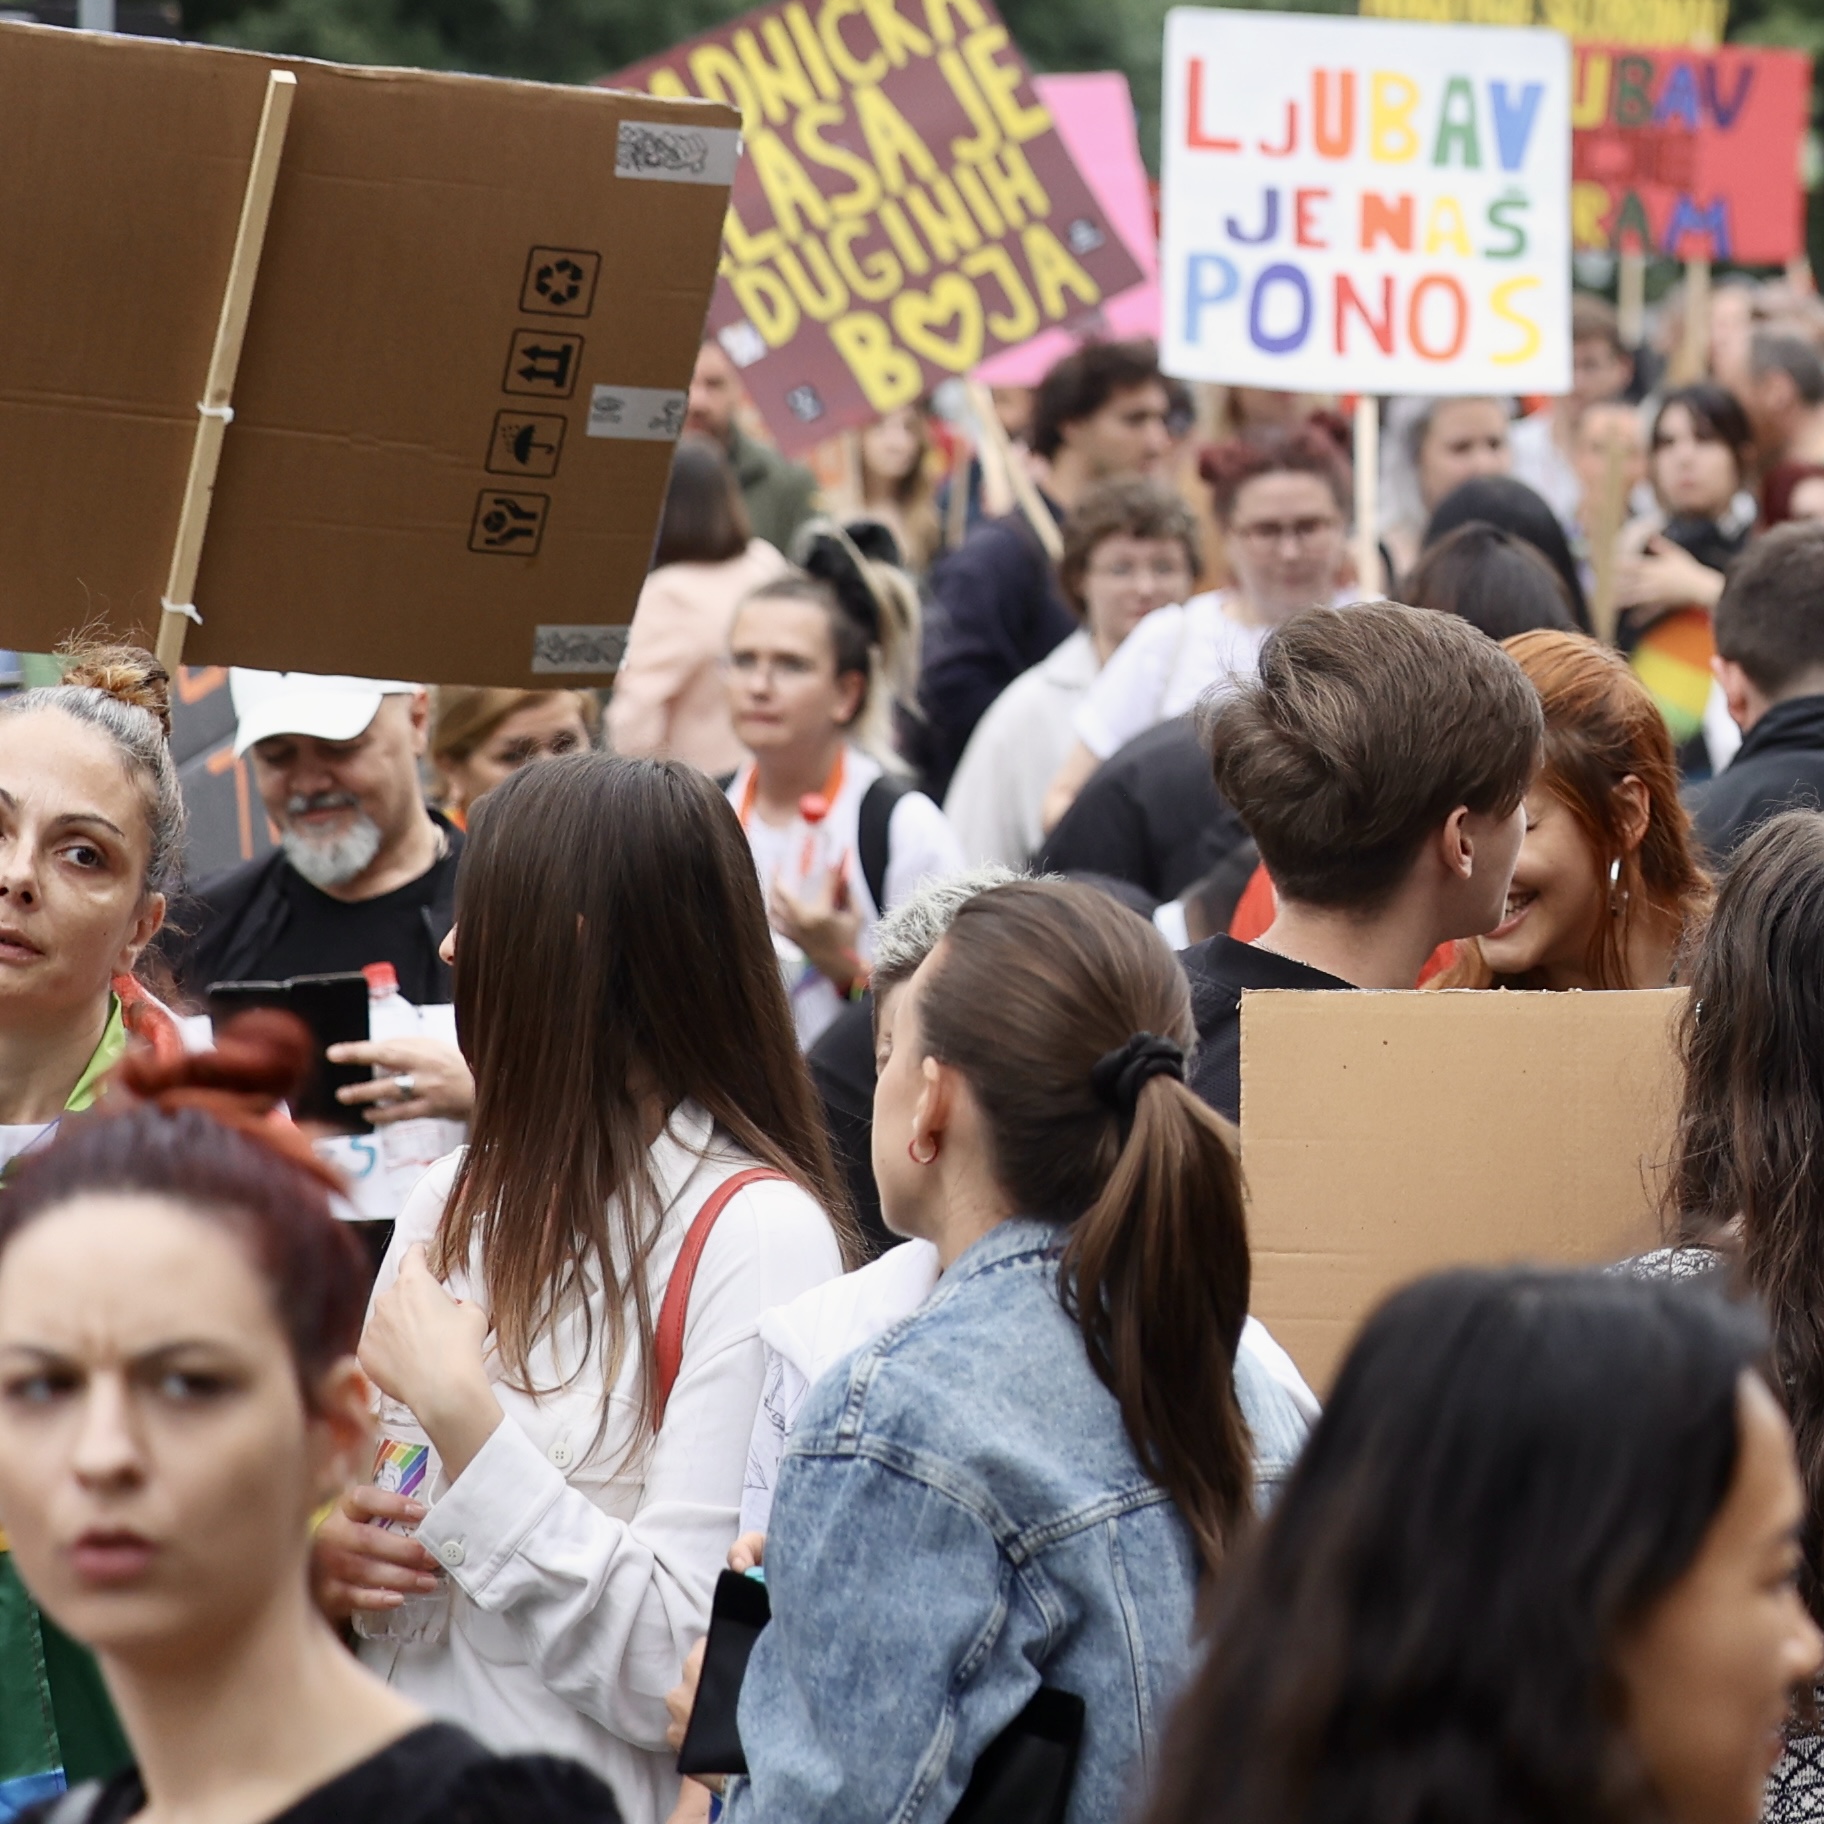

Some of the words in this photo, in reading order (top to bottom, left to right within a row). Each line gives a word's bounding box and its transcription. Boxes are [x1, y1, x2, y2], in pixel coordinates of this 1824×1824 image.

[720, 83, 938, 274] LASA
[937, 25, 1053, 164] JE
[1182, 55, 1546, 173] LJUBAV
[1572, 52, 1756, 133] UBAV
[722, 143, 1052, 348] DUGINIH
[1225, 186, 1330, 250] JE
[1358, 184, 1531, 259] NAŠ
[1572, 181, 1735, 260] RAM
[1182, 252, 1543, 366] PONOS
